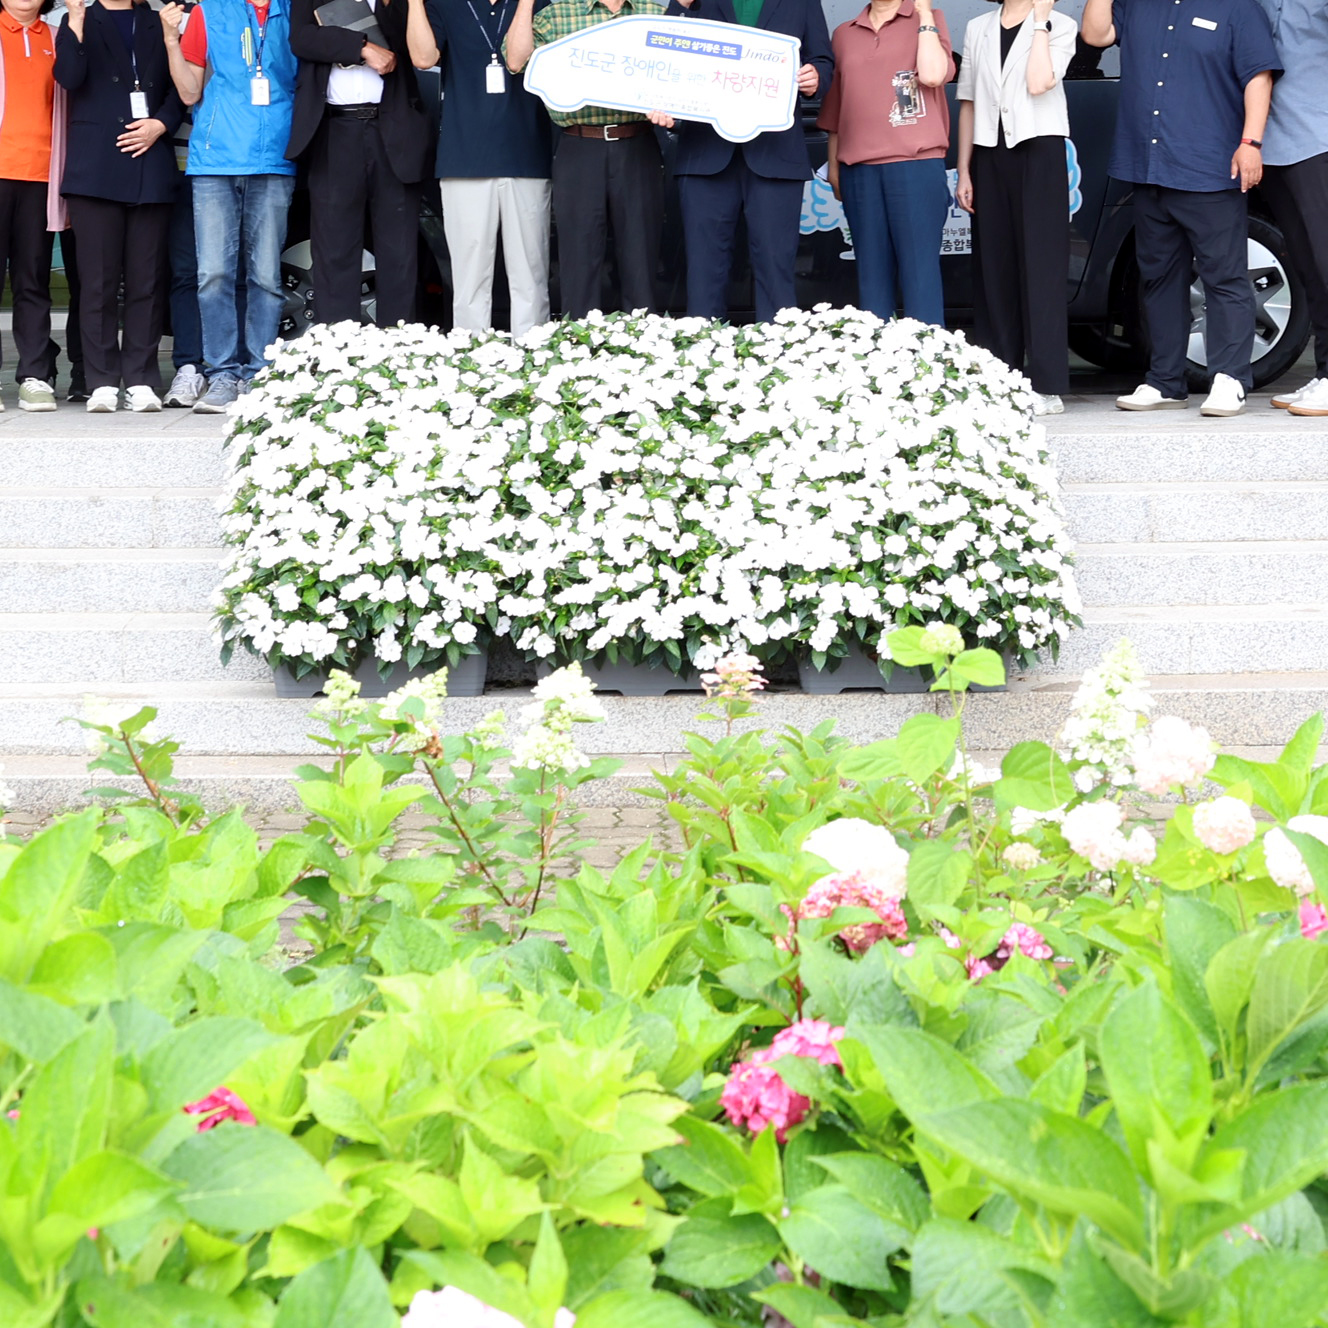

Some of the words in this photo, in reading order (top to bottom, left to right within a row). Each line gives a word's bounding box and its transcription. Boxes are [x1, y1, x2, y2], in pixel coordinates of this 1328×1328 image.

[741, 48, 779, 63] Jindo
[568, 47, 616, 73] 진도군
[621, 55, 681, 83] 장애인을
[711, 70, 780, 99] 차량지원
